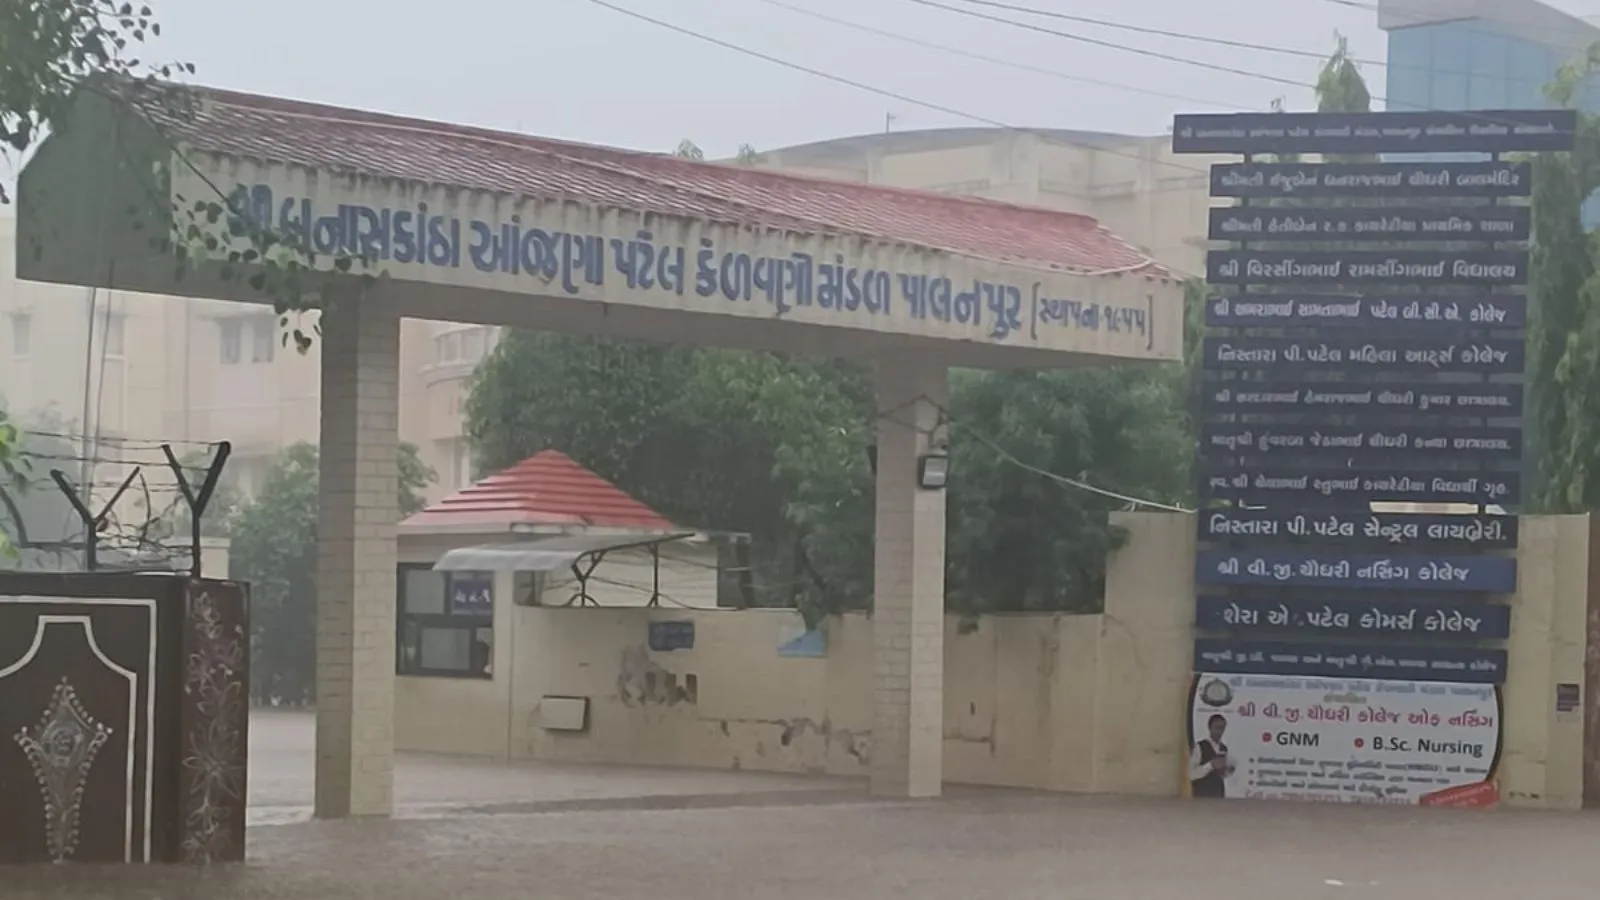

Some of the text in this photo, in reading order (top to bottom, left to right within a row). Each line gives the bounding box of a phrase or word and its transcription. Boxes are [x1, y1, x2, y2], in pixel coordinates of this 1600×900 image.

[1219, 259, 1239, 277] શ્રી
[611, 229, 685, 295] પટેલ
[817, 253, 892, 316] મંડળ
[896, 272, 1023, 339] પાલનપુર
[1370, 299, 1398, 319] પટેલ
[1470, 303, 1507, 323] કોલેજ
[1349, 343, 1397, 364] મહિલા
[1461, 344, 1509, 363] કોલેજ
[1209, 513, 1278, 535] નિસ્તારા
[1363, 516, 1419, 543] સેન્ટ્રલ
[1217, 557, 1239, 575] શ્રી
[1356, 559, 1409, 580] નર્સિંગ
[1418, 561, 1469, 581] કોલેજ
[1223, 602, 1259, 625] શેરા
[1359, 607, 1417, 630] કોમર્સ
[1424, 609, 1482, 632] કોલેજ
[1237, 701, 1256, 718] શ્રી
[1356, 705, 1401, 724] કોલેજ
[1276, 732, 1320, 747] GNM
[1372, 736, 1483, 759] B.Sc. Nursing
